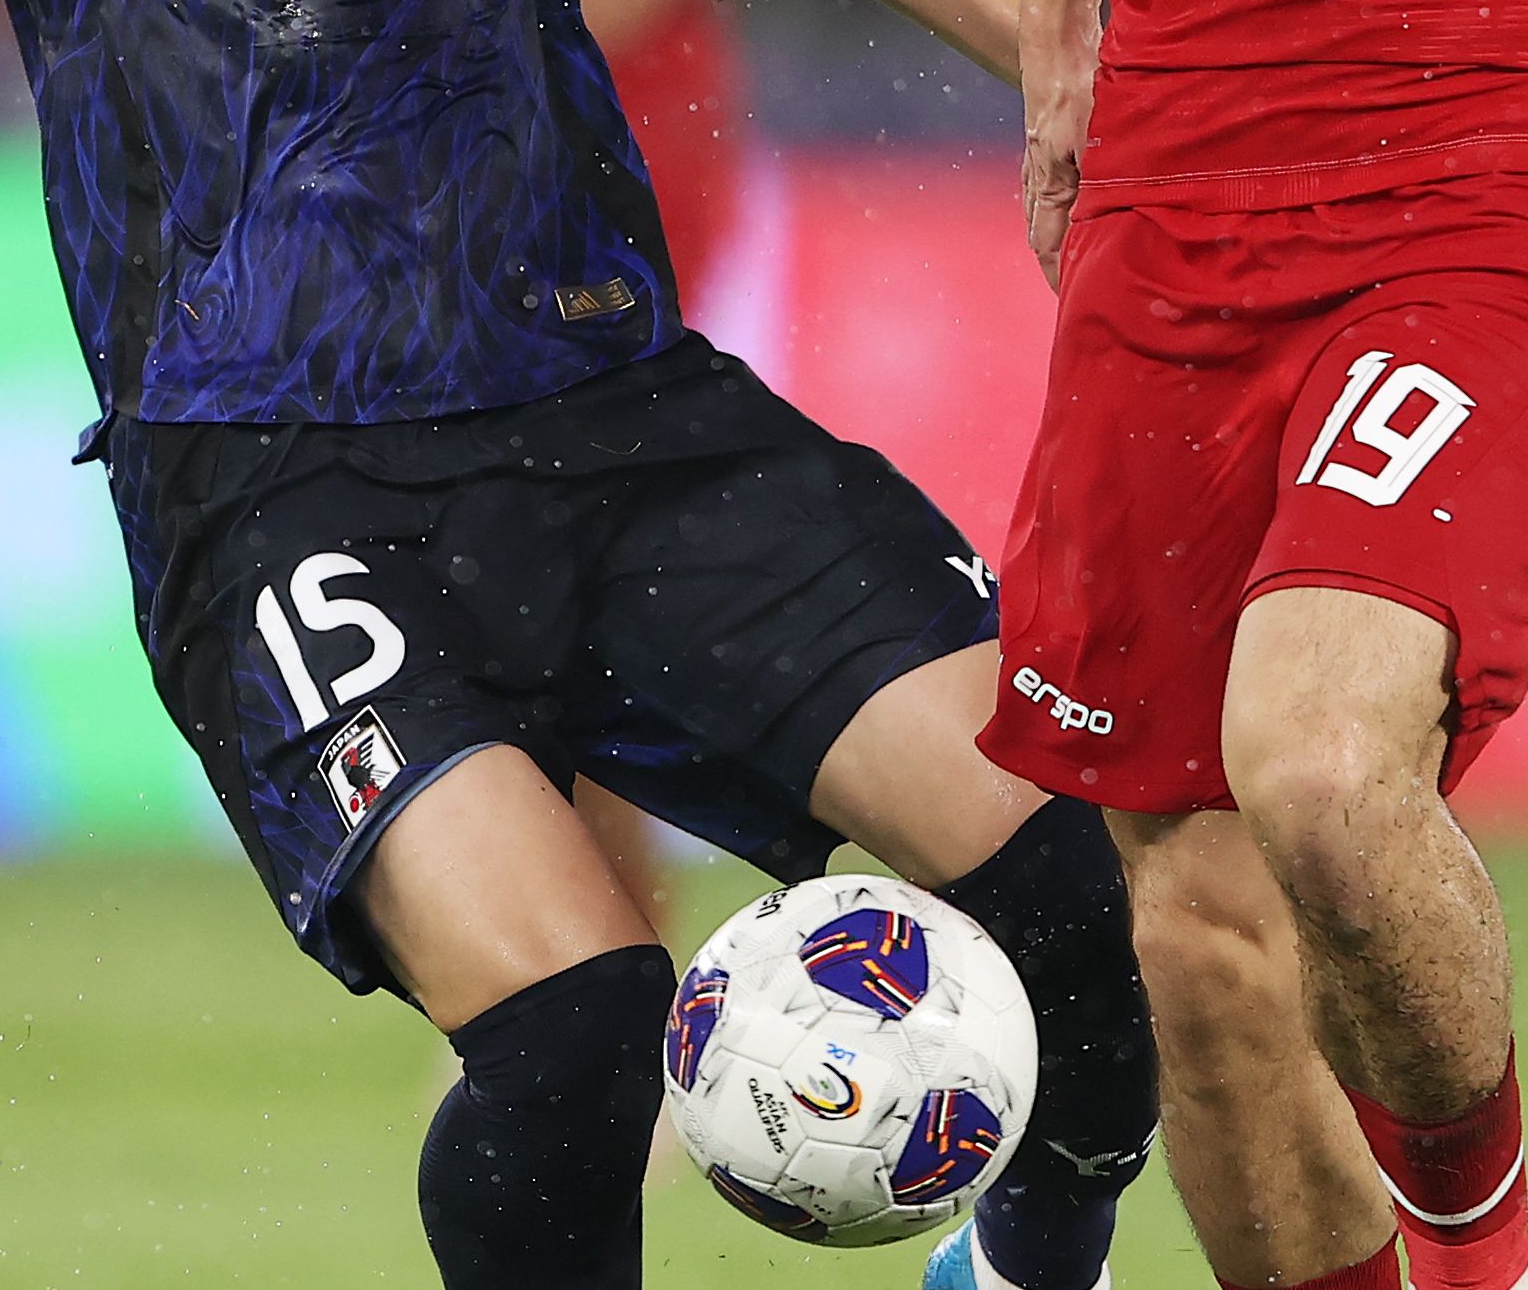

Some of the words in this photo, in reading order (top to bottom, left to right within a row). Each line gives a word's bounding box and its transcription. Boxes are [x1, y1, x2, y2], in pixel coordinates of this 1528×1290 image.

[1295, 350, 1477, 507] 19
[944, 556, 1000, 598] Y-
[255, 552, 407, 733] 15
[1013, 666, 1114, 736] erspo
[328, 724, 361, 761] JAPAN
[747, 1077, 785, 1154] QUALIFIERS
[763, 1092, 788, 1133] ASIAN
